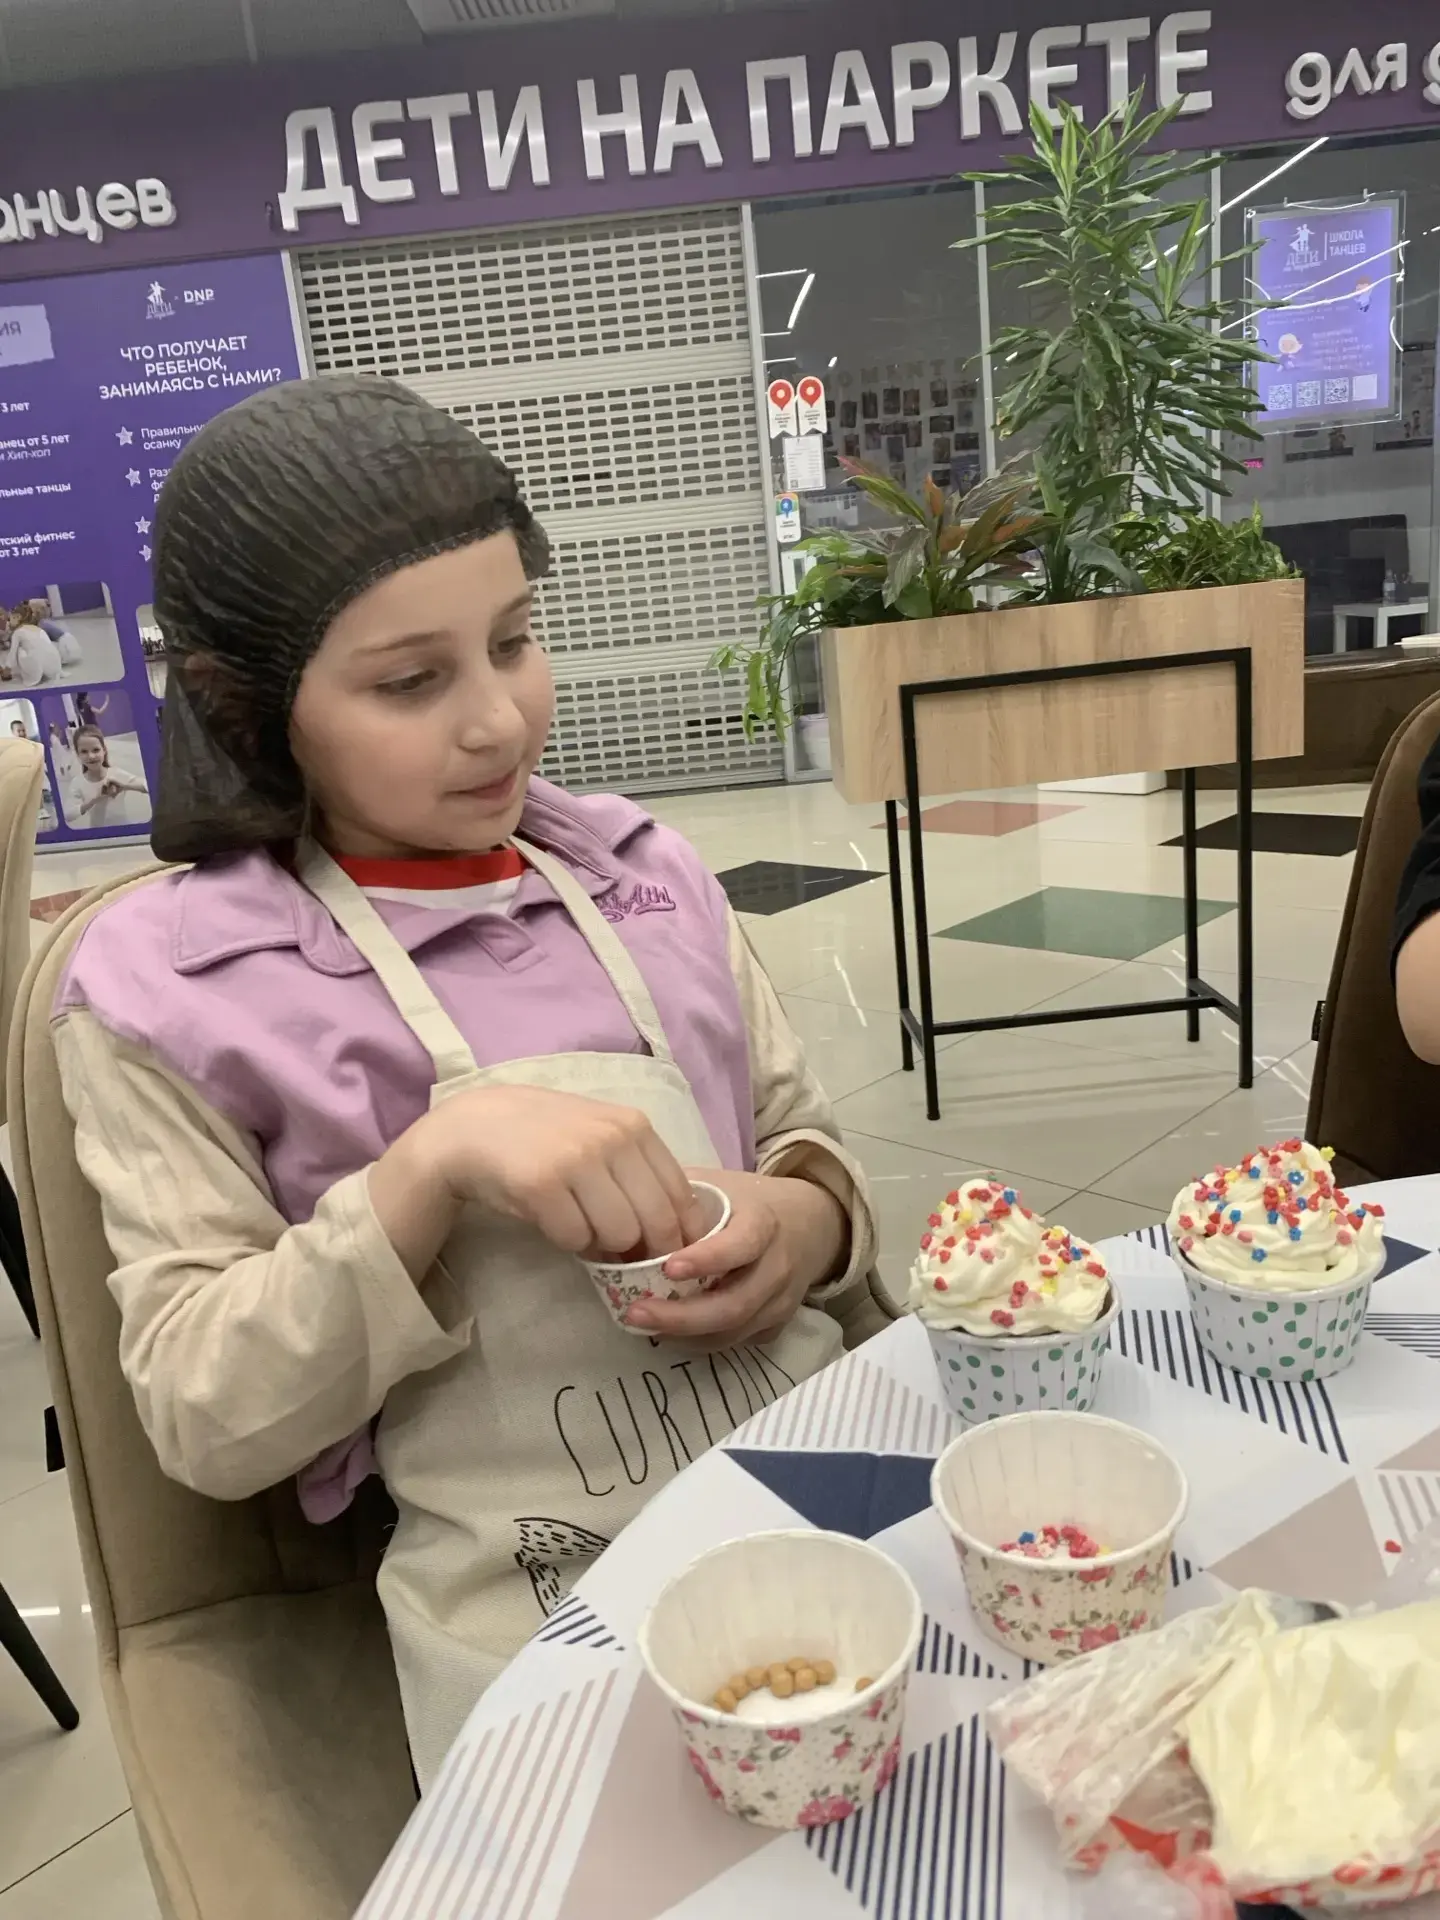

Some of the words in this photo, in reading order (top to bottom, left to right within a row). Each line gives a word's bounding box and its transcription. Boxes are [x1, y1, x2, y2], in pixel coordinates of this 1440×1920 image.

[1285, 42, 1408, 119] для
[278, 86, 551, 231] ДЕТИ
[577, 68, 723, 179] НА
[746, 10, 1213, 162] ПАРКЕТЕ
[1329, 230, 1364, 243] ШКОЛА
[1329, 243, 1366, 257] ТАНЦЕВ
[183, 288, 215, 303] DNP
[120, 345, 154, 361] ЧТО
[158, 336, 248, 358] ПОЛУЧАЕТ
[145, 356, 227, 377] РЕБЕНОК,
[99, 376, 204, 400] ЗАНИМАЯСЬ
[208, 374, 219, 388] С
[222, 367, 282, 387] НАМИ?
[1, 402, 9, 413] 3
[10, 402, 30, 412] лет
[27, 437, 40, 447] от
[41, 434, 49, 445] 5
[51, 434, 70, 444] лет
[143, 439, 182, 450] осанку
[36, 483, 71, 494] танцы
[34, 531, 76, 545] фитнес
[12, 546, 19, 557] 3
[21, 546, 40, 556] лет
